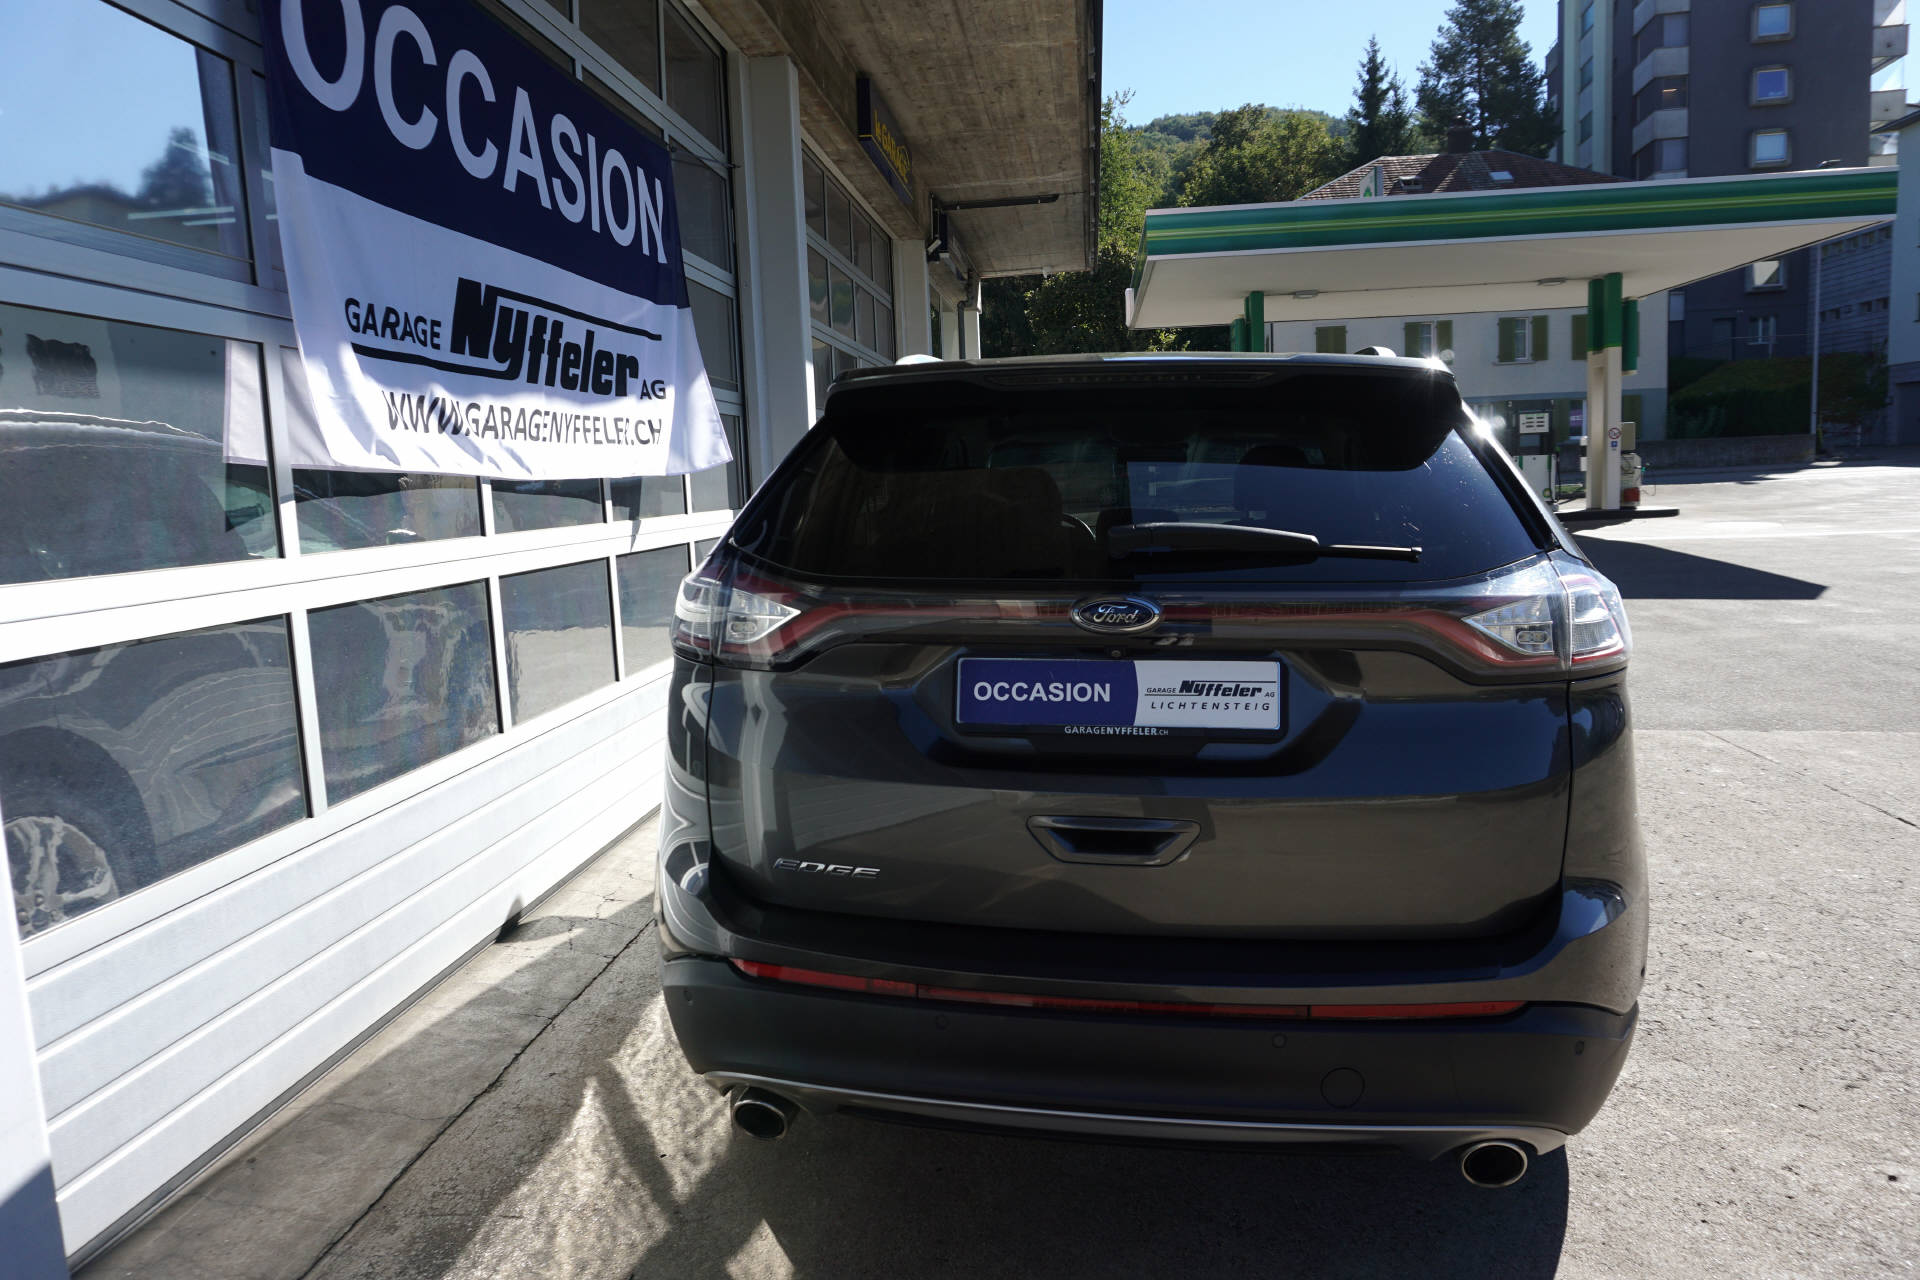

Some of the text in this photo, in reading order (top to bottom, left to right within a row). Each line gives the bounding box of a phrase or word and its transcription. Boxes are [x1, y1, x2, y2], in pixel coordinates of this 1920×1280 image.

[280, 0, 668, 264] OCCASION
[344, 277, 667, 400] GARAGE Nyffeler AG
[382, 390, 662, 446] WWW.GARAGENYFFELER.CH
[1093, 603, 1140, 623] Ford
[973, 682, 1111, 703] OCCASION
[1178, 680, 1263, 697] Nyffeler
[1151, 701, 1271, 711] LICHTENSTEIG
[1064, 726, 1169, 736] GARAGENYFFELER.CH
[773, 858, 881, 879] EDGE
